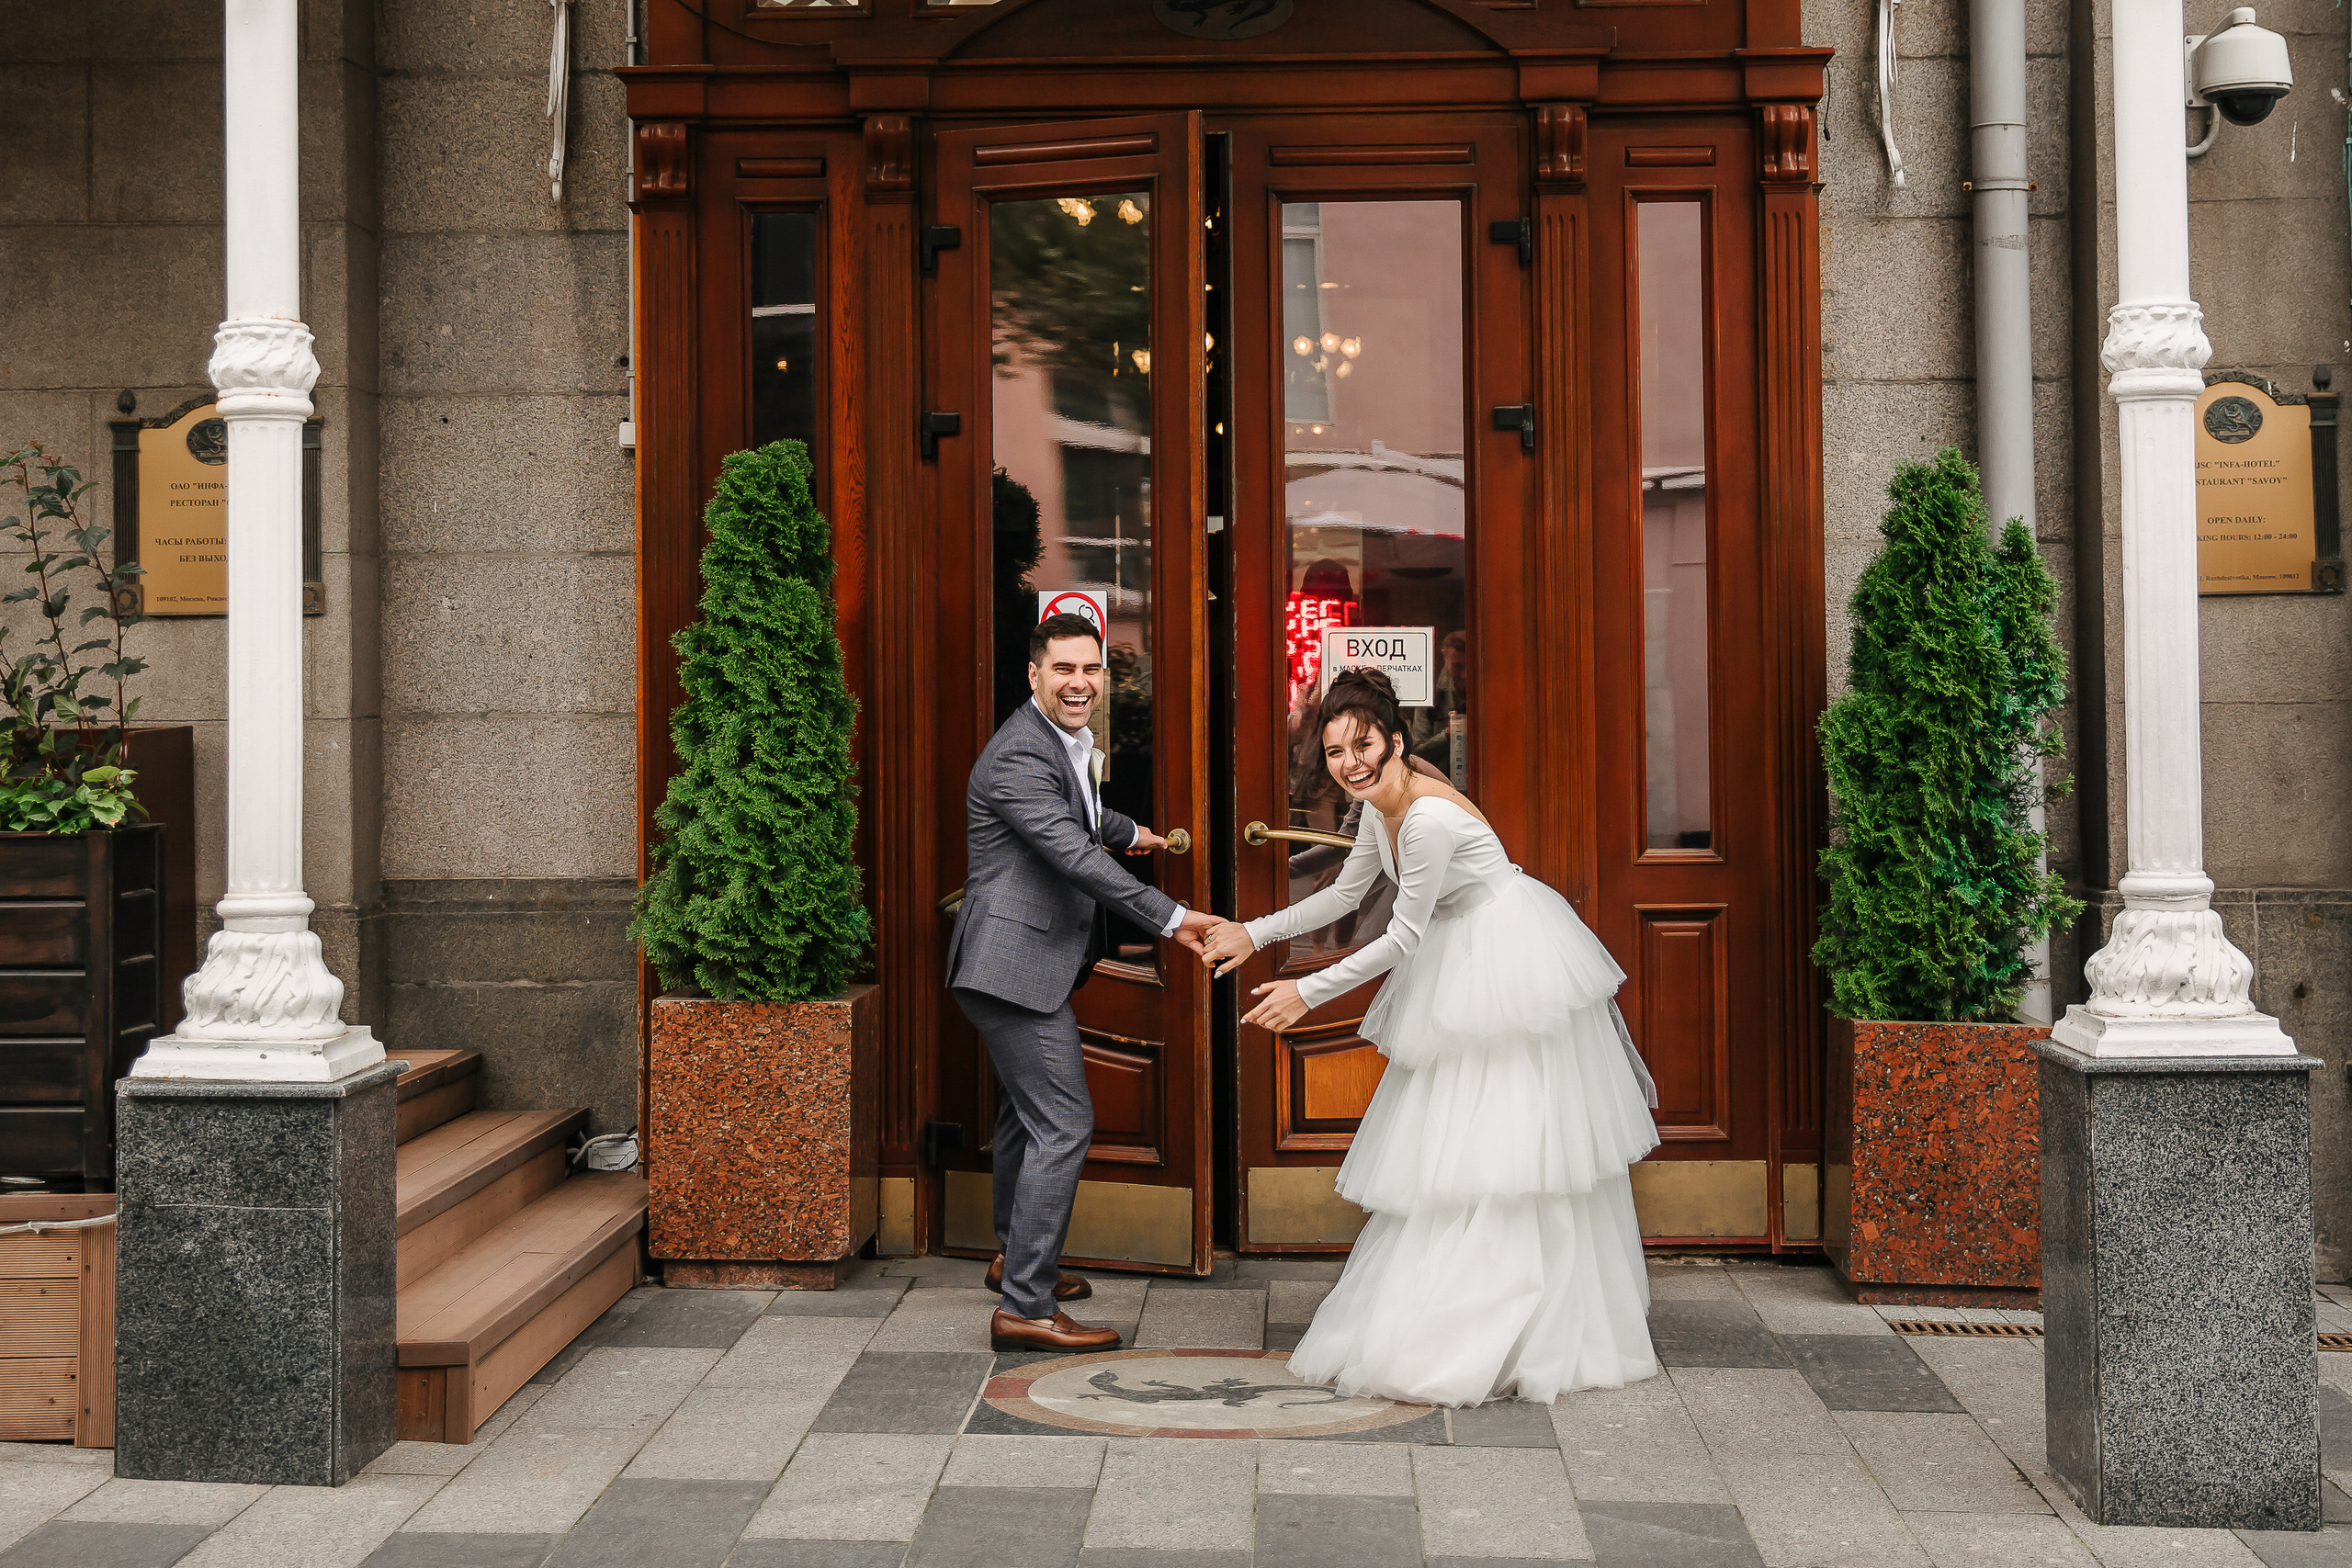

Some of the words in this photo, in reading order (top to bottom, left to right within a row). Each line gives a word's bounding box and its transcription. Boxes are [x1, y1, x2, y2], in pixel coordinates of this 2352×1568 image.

[2214, 459, 2280, 468] "INFA-HOTEL"
[2196, 478, 2245, 486] STAURANT
[2247, 477, 2288, 485] "SAVOY"
[170, 499, 219, 507] РЕСТОРАН
[2207, 516, 2233, 525] OPEN
[2235, 515, 2266, 524] DAILY:
[154, 537, 183, 546] ЧАСЫ
[2197, 534, 2218, 542] KING
[179, 554, 196, 562] БЕЗ
[198, 554, 228, 563] ВЫХО
[1347, 638, 1406, 660] ВХОД
[1376, 664, 1422, 672] ПЕРЧАТКАХ
